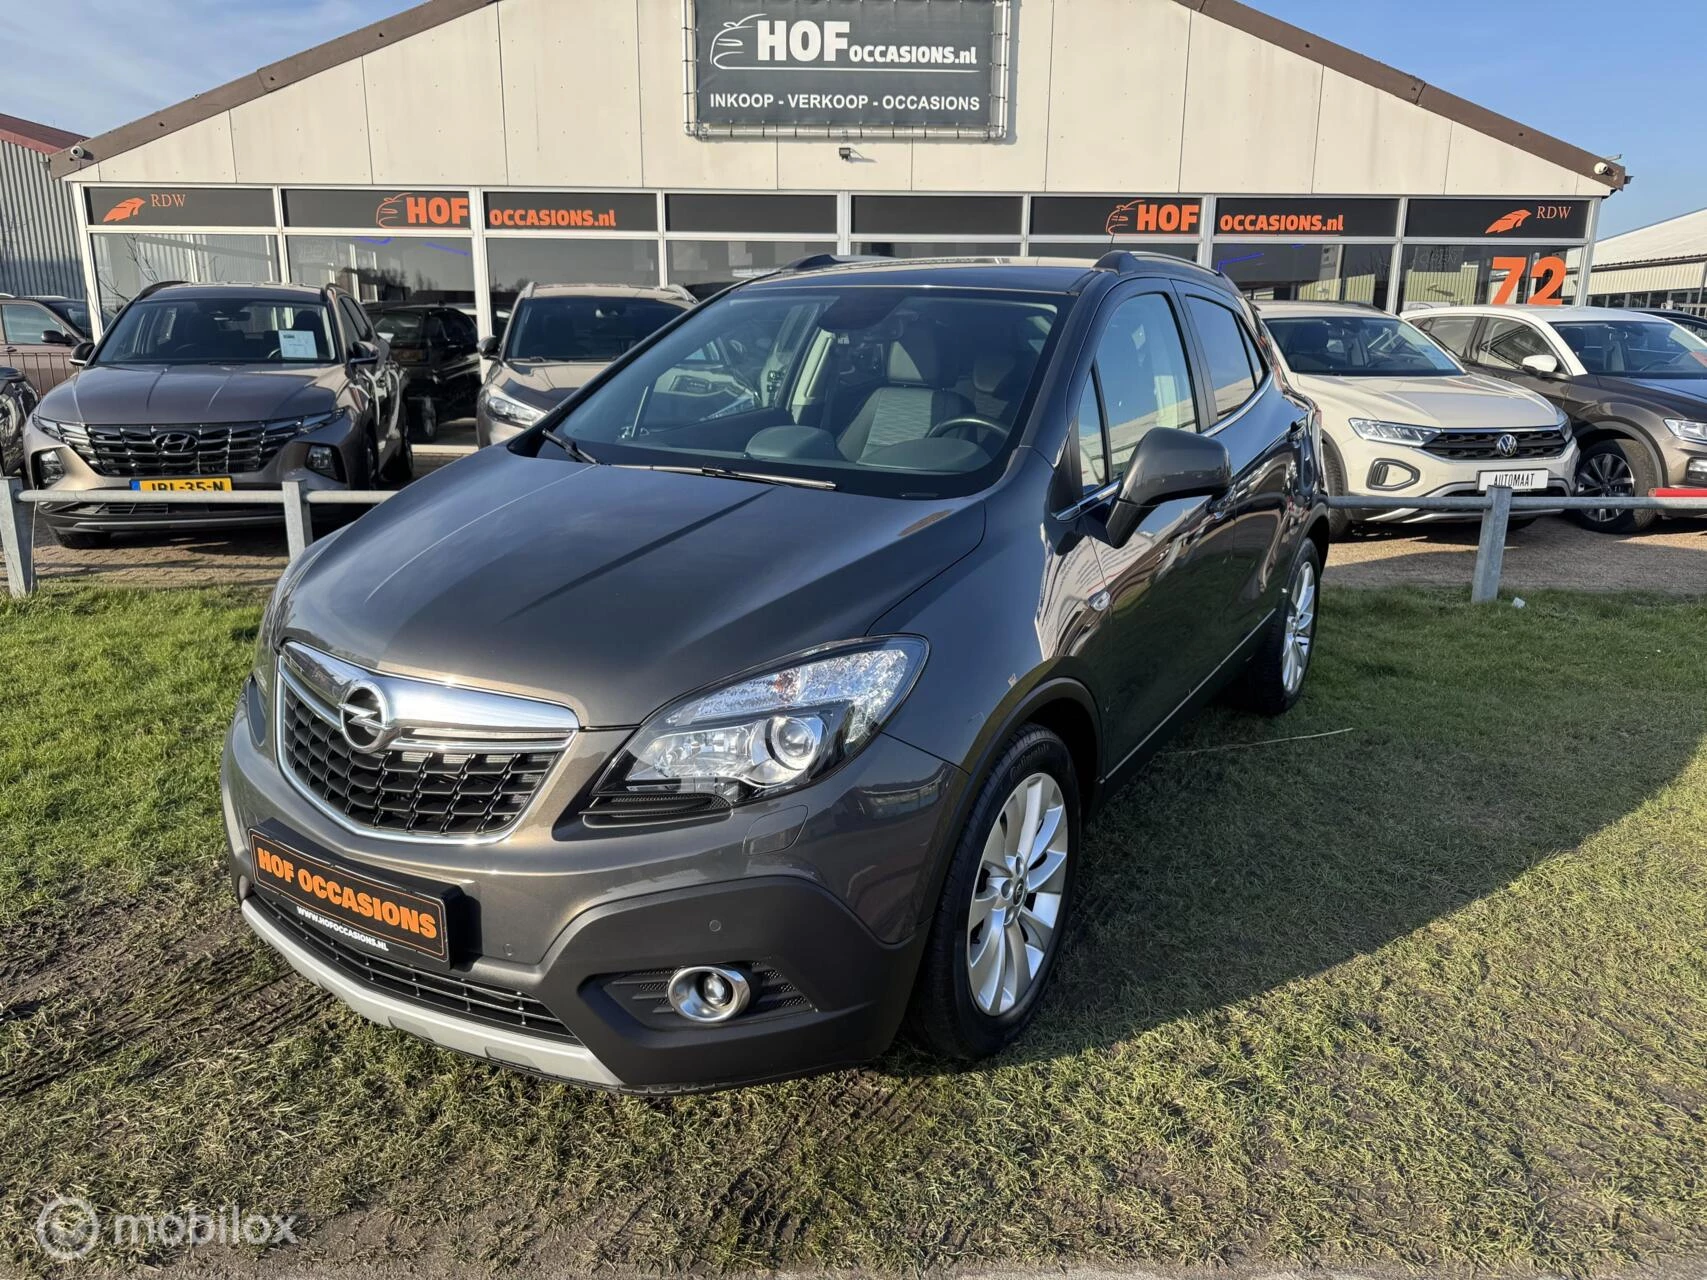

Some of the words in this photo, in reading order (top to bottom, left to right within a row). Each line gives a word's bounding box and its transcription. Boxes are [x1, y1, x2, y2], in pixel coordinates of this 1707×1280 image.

[757, 20, 850, 61] HOF
[849, 45, 977, 64] OCCASIONS.nl
[710, 93, 774, 108] INKOOP
[787, 94, 869, 110] VERKOOP
[882, 95, 980, 111] OCCASIONS
[150, 193, 187, 207] RDW
[406, 196, 469, 225] HOF
[489, 208, 616, 228] OCCASIONS.nl
[1536, 206, 1572, 220] RDW
[1136, 204, 1200, 232] HOF
[1219, 213, 1344, 232] OCCASIONS.nl
[1491, 255, 1568, 306] 72
[1494, 473, 1535, 487] AUTOMAAT
[257, 847, 295, 883] HOF
[297, 868, 438, 939] OCCASIONS
[296, 905, 390, 952] WWW.HOFOCCASIONS.NL
